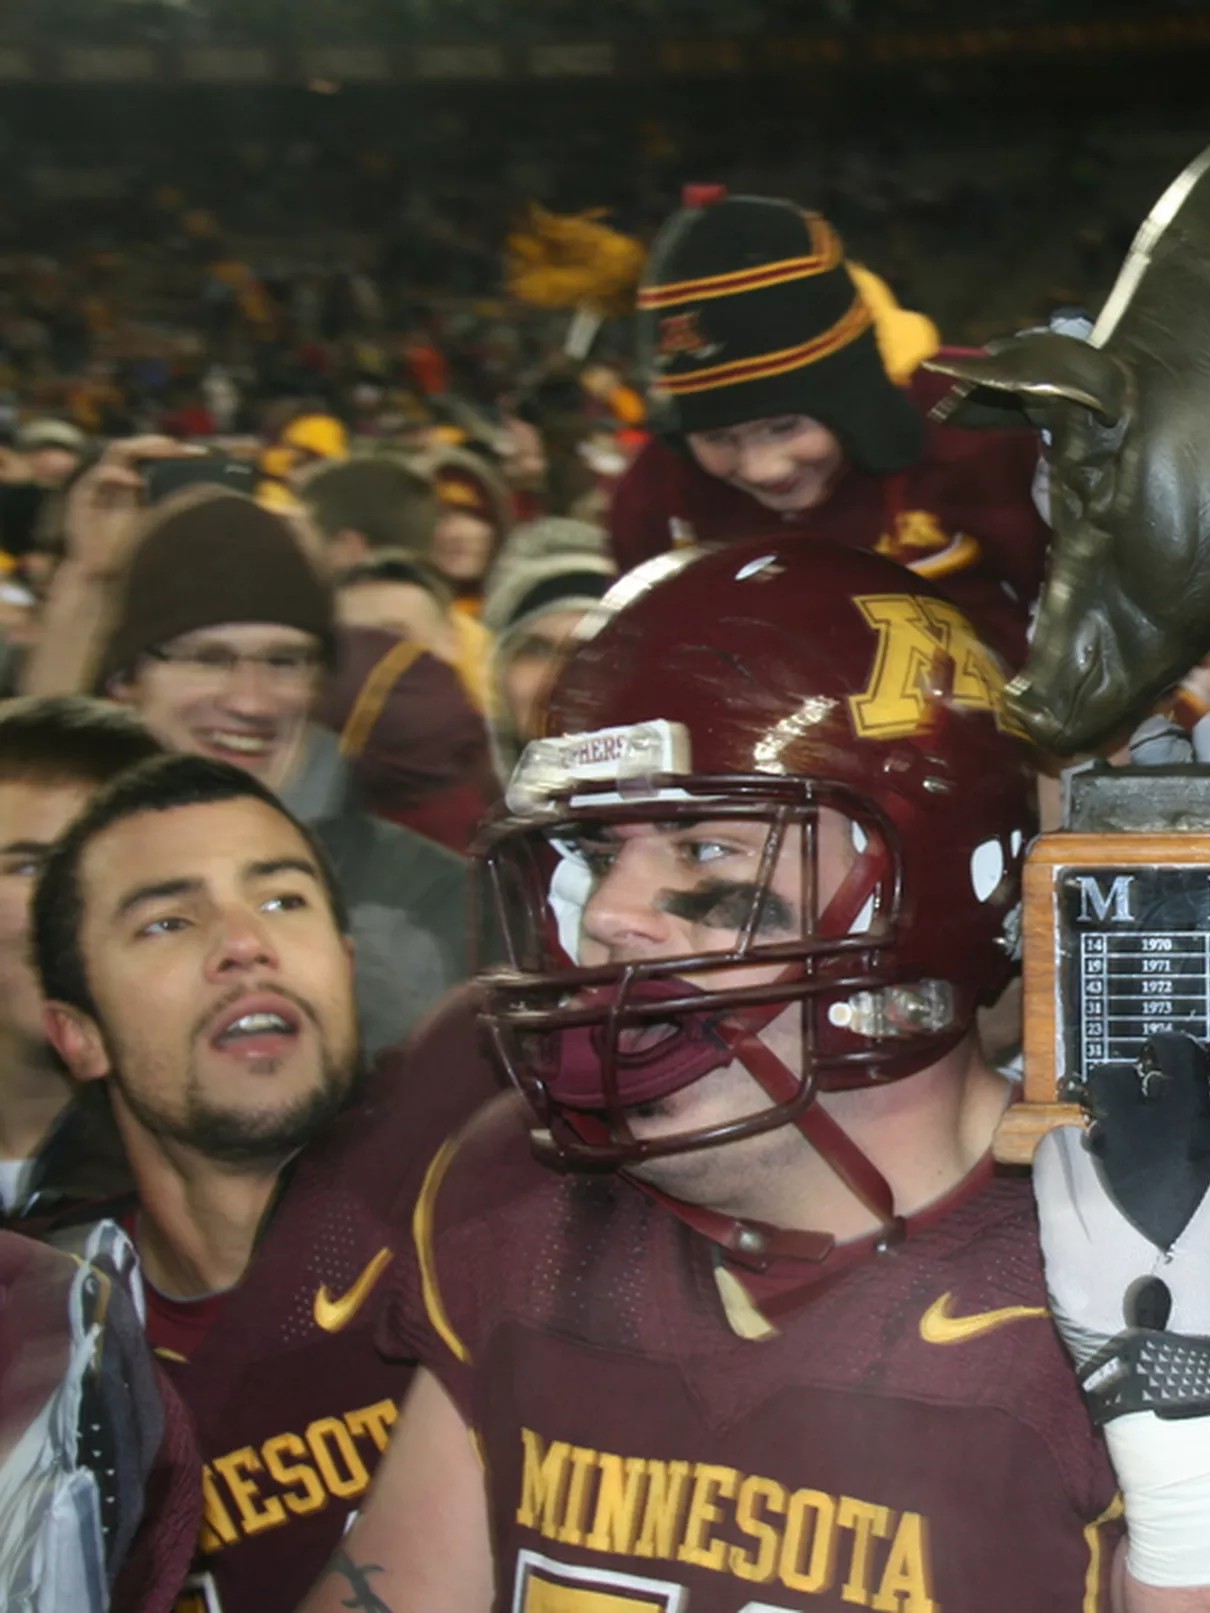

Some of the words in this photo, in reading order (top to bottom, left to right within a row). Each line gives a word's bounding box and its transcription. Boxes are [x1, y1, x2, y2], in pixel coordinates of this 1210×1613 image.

[1076, 875, 1135, 921] M
[1141, 938, 1173, 951] 1970
[1141, 959, 1171, 972] 1971
[1141, 981, 1173, 993] 1972
[1086, 1002, 1102, 1014] 31
[1141, 1002, 1173, 1014] 1973
[1087, 1023, 1102, 1035] 23
[516, 1427, 940, 1613] MINNESOTA
